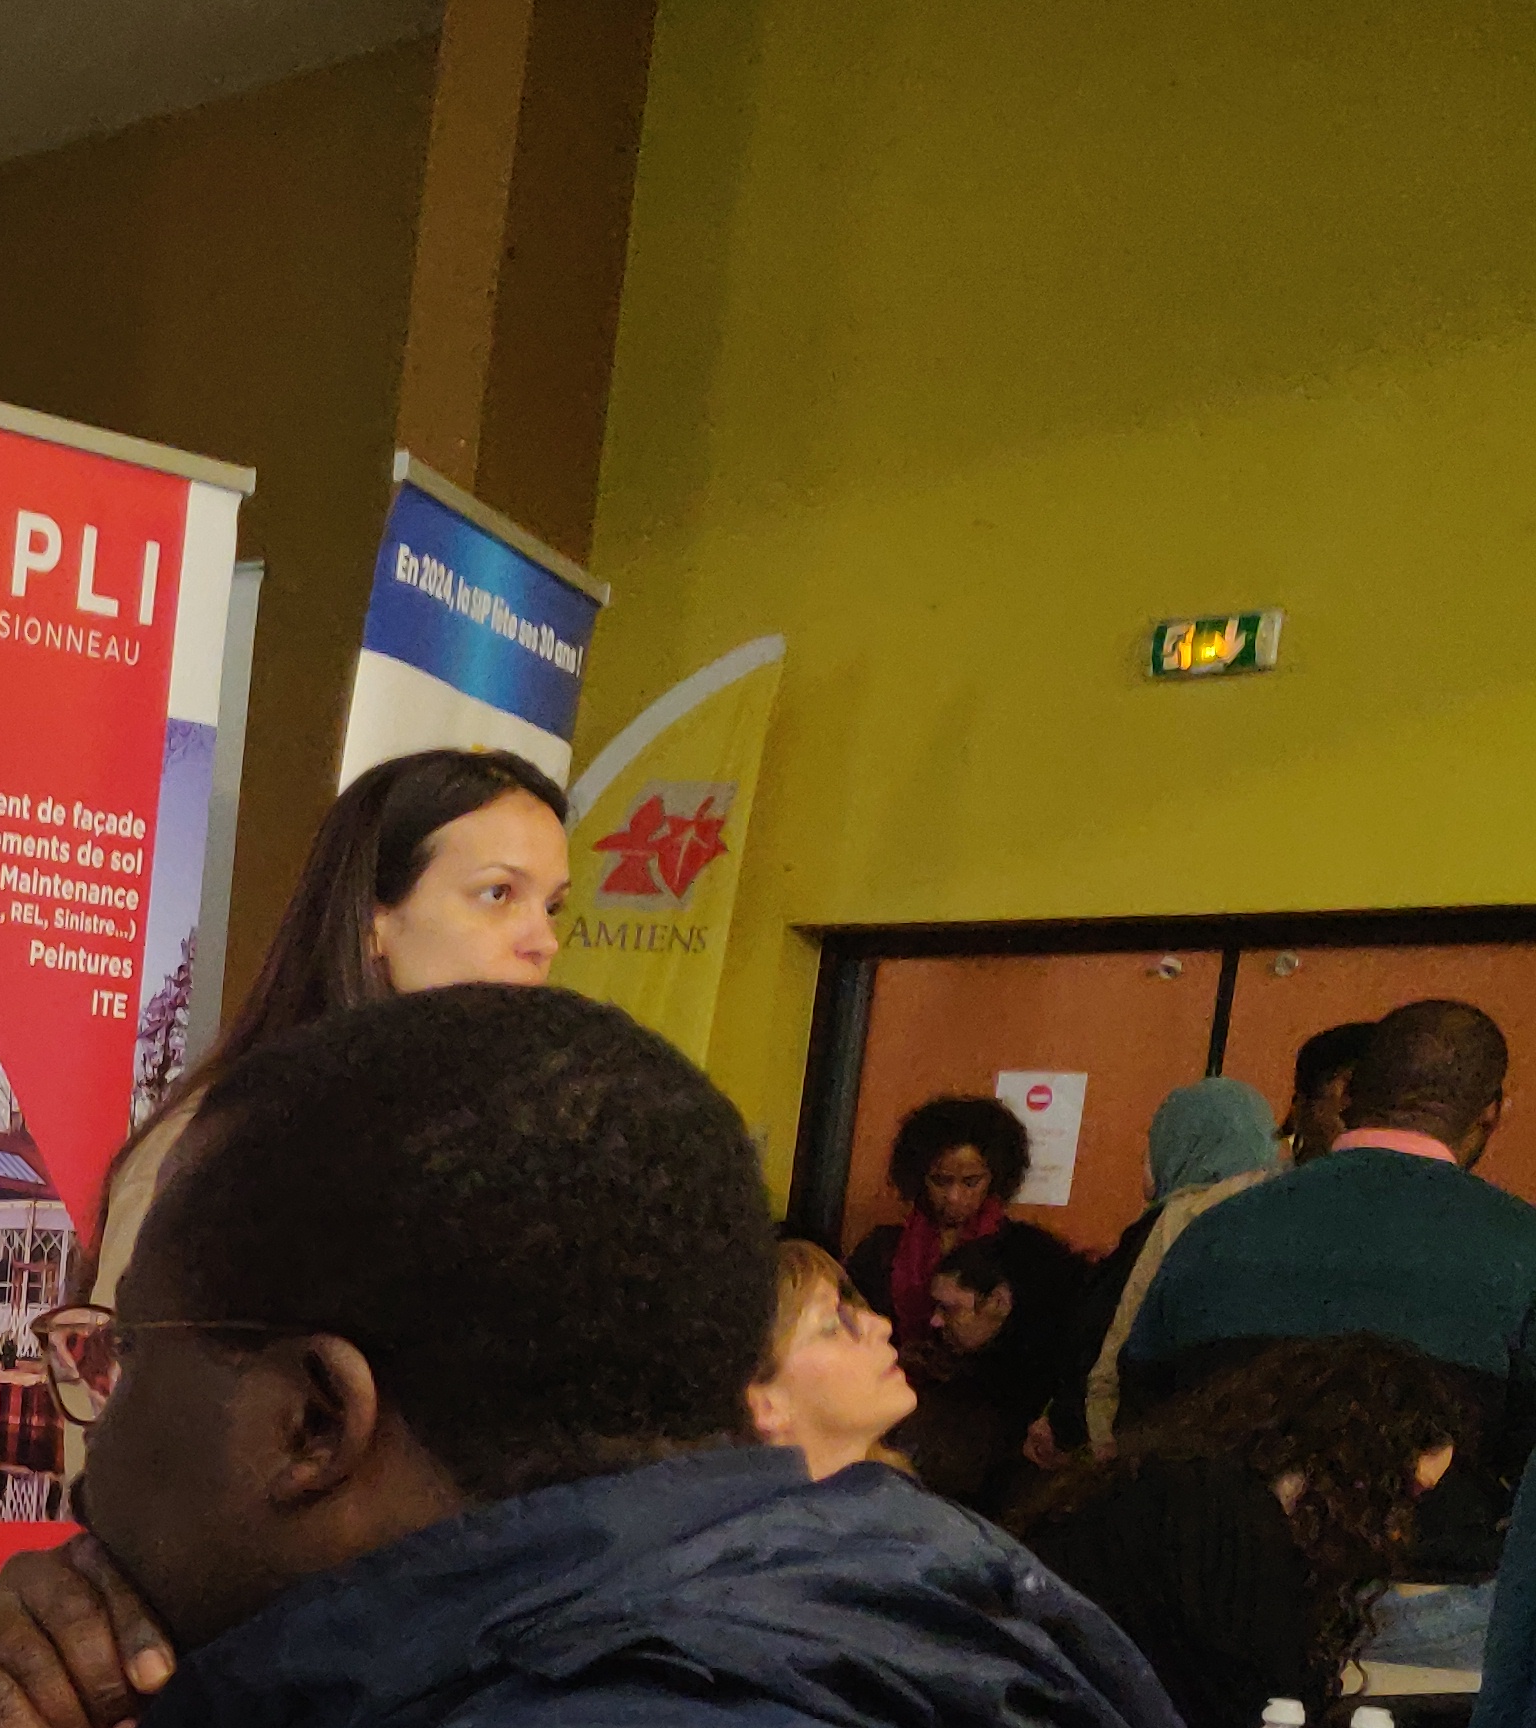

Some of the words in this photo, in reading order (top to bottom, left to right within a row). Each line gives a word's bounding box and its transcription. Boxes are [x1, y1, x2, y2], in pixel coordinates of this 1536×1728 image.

[396, 542, 419, 587] En
[38, 794, 65, 826] de
[72, 799, 146, 841] façade
[77, 838, 104, 869] de
[110, 846, 143, 876] sol
[0, 863, 140, 911] Maintenance
[10, 902, 50, 932] REL,
[564, 916, 708, 953] AMIENS
[29, 938, 134, 979] Peintures
[91, 988, 128, 1020] ITE
